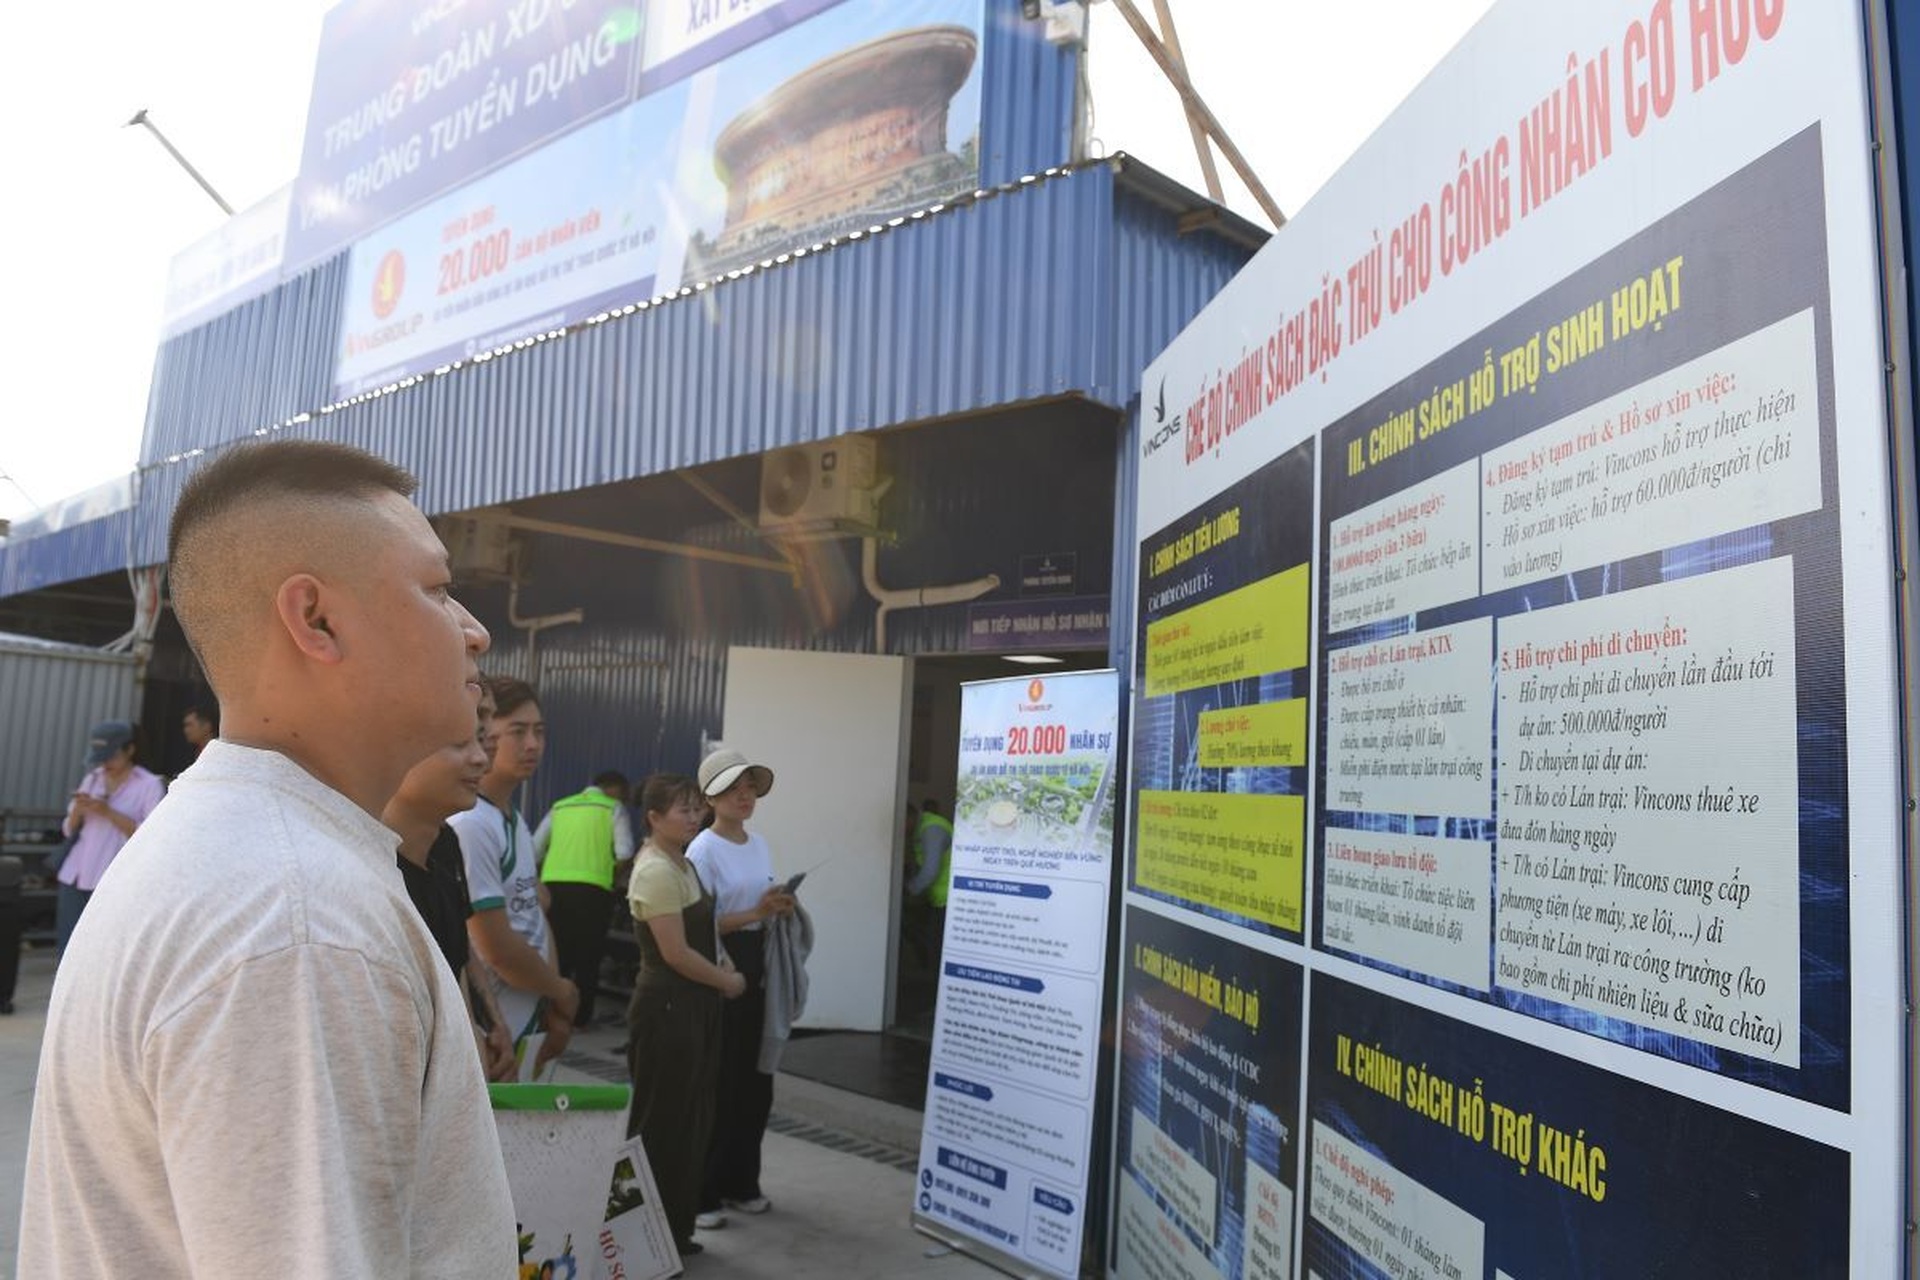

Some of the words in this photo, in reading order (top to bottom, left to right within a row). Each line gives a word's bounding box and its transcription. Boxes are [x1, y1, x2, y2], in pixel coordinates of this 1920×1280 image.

[525, 20, 616, 106] DỤNG
[324, 81, 405, 158] TRUNG
[437, 228, 511, 296] 20.000
[1226, 346, 1263, 436] CHÍNH
[1267, 312, 1304, 406] SÁCH
[1309, 271, 1342, 384] ĐẶC
[1348, 229, 1382, 345] THÙ
[1390, 202, 1431, 314] CHO
[1439, 135, 1510, 277] CÔNG
[1519, 46, 1612, 218] NHÂN
[1348, 439, 1365, 477] III.
[1369, 408, 1414, 465] CHÍNH
[1419, 382, 1464, 440] SÁCH
[1470, 348, 1495, 413] HỖ
[1500, 332, 1540, 397] TRỢ
[1547, 301, 1604, 373] SINH
[1612, 256, 1683, 341] HOẠT
[1486, 470, 1496, 488] 4.
[1499, 459, 1528, 483] Đăng
[1549, 440, 1573, 465] tạm
[1577, 427, 1598, 449] trú
[1602, 421, 1614, 443] &
[1619, 402, 1641, 436] Hồ
[1645, 402, 1664, 425] sơ
[1666, 390, 1691, 417] xin
[1696, 371, 1736, 406] việc:
[1551, 474, 1575, 501] tạm
[1605, 443, 1658, 479] Vincons
[1662, 421, 1681, 460] hỗ
[1685, 420, 1710, 449] trợ
[1714, 408, 1751, 441] thực
[1757, 388, 1796, 423] hiện
[1537, 510, 1555, 534] xin
[1558, 502, 1587, 531] việc:
[1591, 481, 1608, 520] hỗ
[1611, 489, 1633, 513] trợ
[1636, 449, 1751, 505] 60.000đ/người
[1428, 633, 1452, 656] KTX
[1501, 652, 1511, 671] 5.
[1516, 641, 1532, 669] Hỗ
[1536, 646, 1555, 671] trợ
[1558, 640, 1577, 661] chi
[1581, 635, 1602, 665] phí
[1607, 632, 1621, 655] di
[1626, 616, 1687, 656] chuyển:
[1519, 675, 1537, 702] Hỗ
[1540, 683, 1559, 704] trợ
[1560, 675, 1580, 698] chi
[1582, 670, 1603, 703] phí
[1607, 669, 1621, 694] di
[1625, 656, 1676, 697] chuyển
[1681, 654, 1706, 685] lần
[1711, 648, 1743, 682] đầu
[1749, 651, 1774, 679] tới
[1007, 724, 1066, 755] 20.000
[1519, 716, 1535, 740] dự
[1537, 715, 1555, 736] án:
[1560, 705, 1667, 736] 500.000đ/người
[1458, 756, 1483, 781] công
[1519, 750, 1534, 772] Di
[1536, 743, 1578, 777] chuyển
[1582, 750, 1600, 775] tại
[1602, 750, 1621, 774] dự
[1625, 747, 1647, 770] án:
[1535, 786, 1549, 807] ko
[1552, 786, 1566, 807] có
[1570, 785, 1594, 808] Lán
[1599, 789, 1627, 814] trại:
[1632, 786, 1691, 811] Vincons
[1697, 786, 1733, 813] thuê
[1737, 795, 1759, 813] xe
[1500, 818, 1522, 840] đưa
[1524, 819, 1546, 842] đón
[1550, 822, 1580, 850] hàng
[1584, 825, 1616, 852] ngày
[1535, 857, 1548, 878] có
[1552, 858, 1575, 881] Lán
[1579, 863, 1608, 888] trại:
[1613, 863, 1669, 892] Vincons
[1673, 876, 1713, 905] cung
[1718, 867, 1750, 909] cấp
[1500, 888, 1542, 918] phương
[1546, 896, 1568, 920] tiện
[1572, 899, 1591, 922] (xe
[1595, 902, 1626, 932] máy,
[1629, 912, 1648, 930] xe
[1706, 916, 1724, 944] di
[1500, 918, 1539, 951] chuyển
[1542, 931, 1555, 951] từ
[1558, 931, 1582, 958] Lán
[1586, 940, 1610, 964] trại
[1613, 949, 1630, 966] ra
[1633, 948, 1670, 983] công
[1675, 959, 1732, 997] trường
[1737, 965, 1766, 999] (ko
[1500, 954, 1520, 980] bao
[1522, 956, 1548, 989] gồm
[1551, 970, 1570, 992] chi
[1572, 975, 1594, 1001] phí
[1598, 981, 1636, 1011] nhiên
[1640, 990, 1669, 1021] liệu
[1673, 998, 1688, 1024] &
[1693, 1004, 1723, 1033] sữa
[1729, 1010, 1783, 1053] chữa)
[1355, 1042, 1401, 1101] CHÍNH
[1406, 1062, 1453, 1127] SÁCH
[1458, 1078, 1484, 1142] HỖ
[1491, 1102, 1533, 1177] TRỢ
[1538, 1124, 1606, 1202] KHÁC
[1401, 1226, 1412, 1249] 01
[1415, 1235, 1441, 1273] tháng
